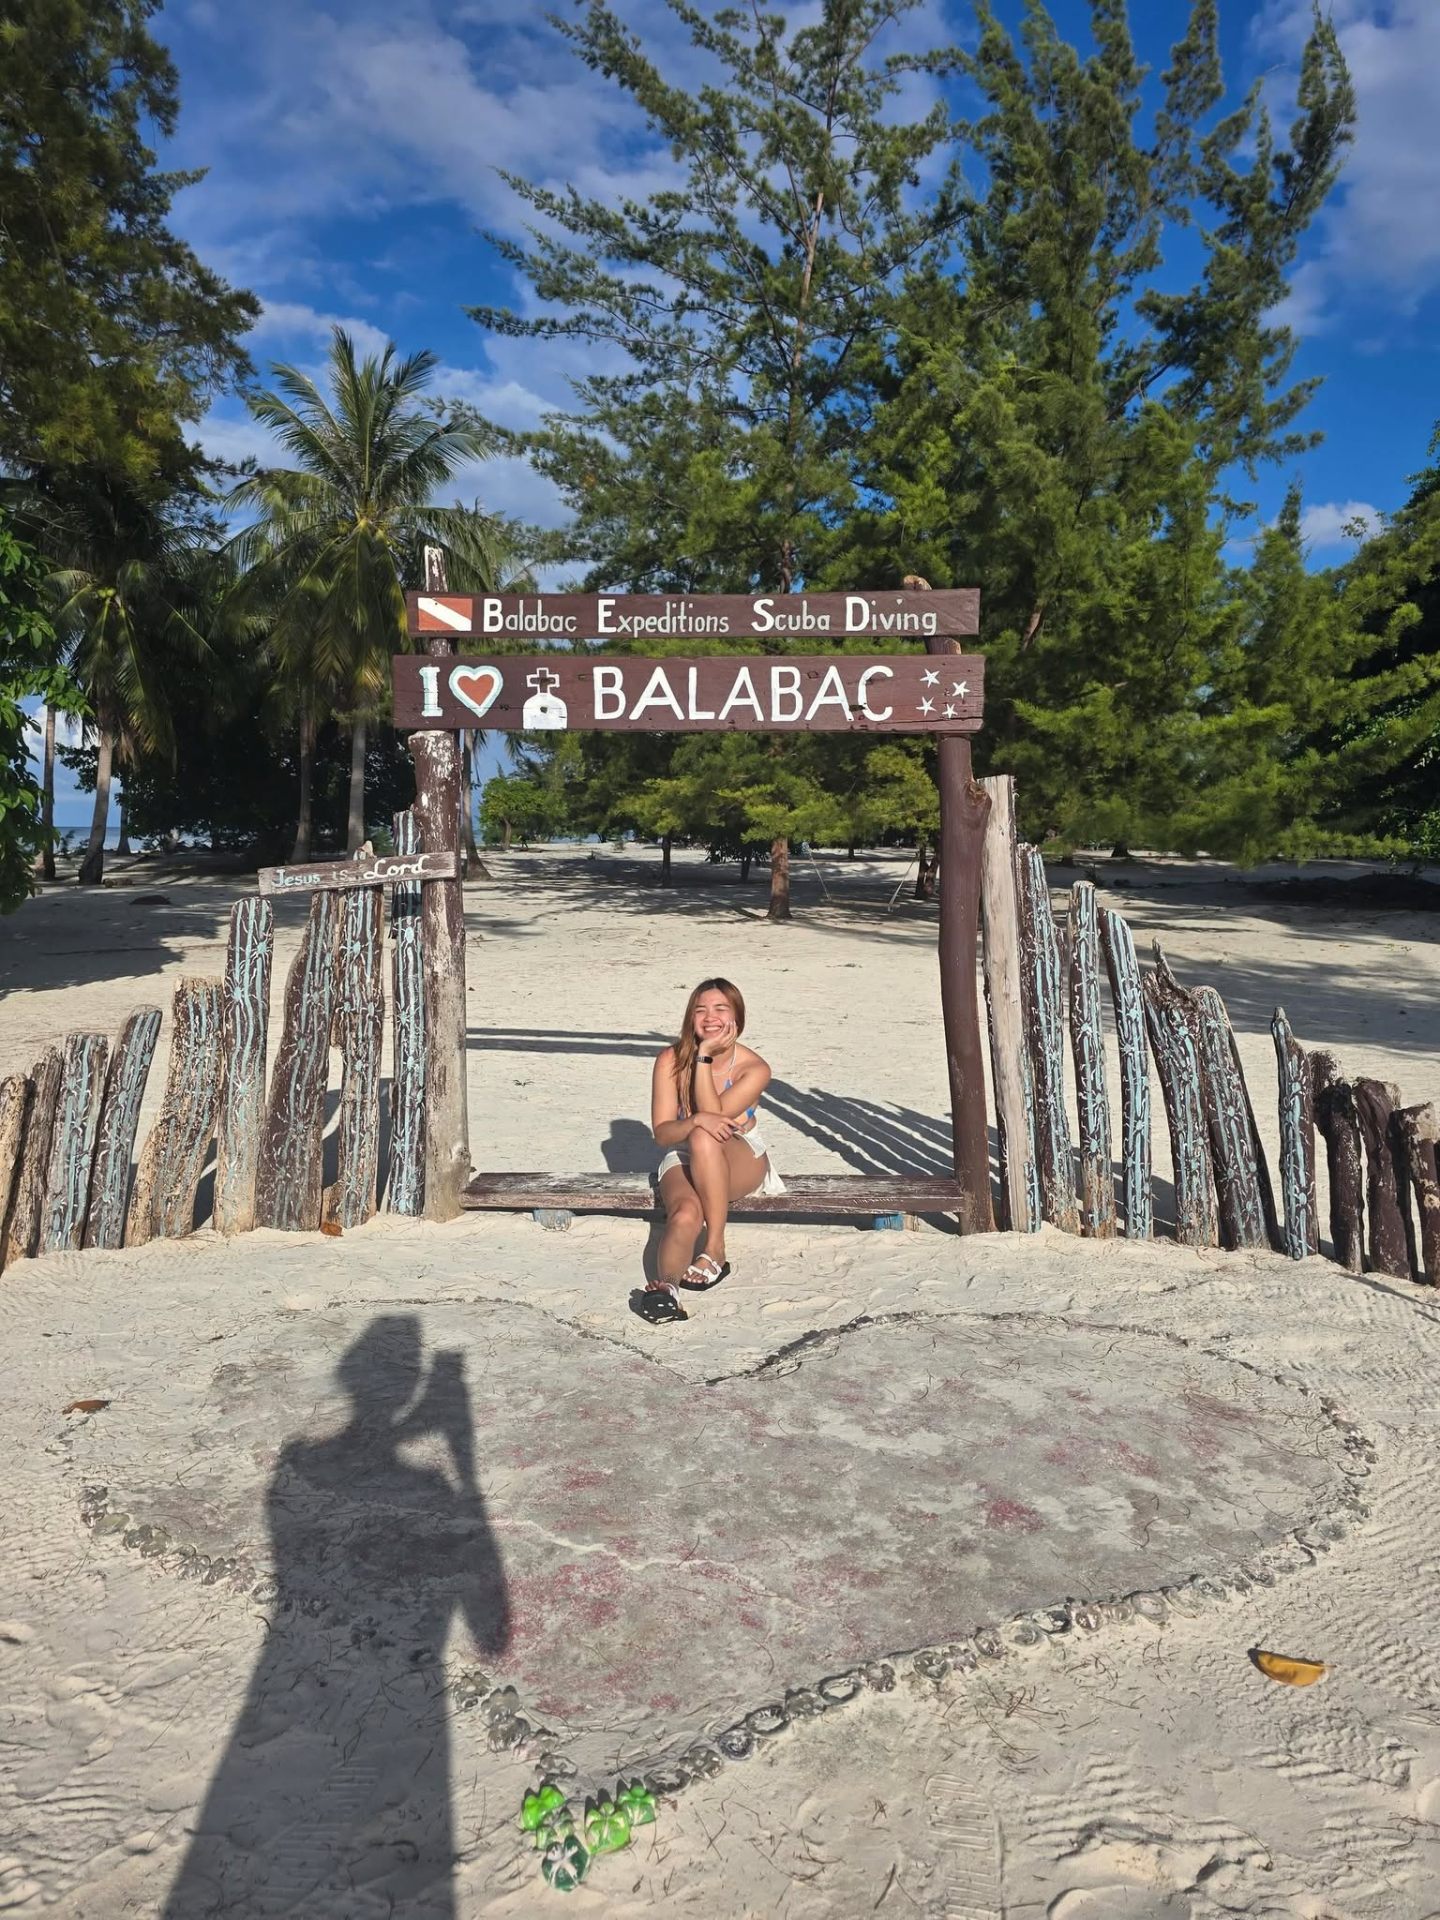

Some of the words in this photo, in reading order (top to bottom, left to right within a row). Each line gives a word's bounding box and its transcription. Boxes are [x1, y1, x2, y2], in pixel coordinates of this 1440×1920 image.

[483, 599, 577, 633] Balabac
[598, 599, 729, 636] Expeditions
[751, 599, 831, 632] Scuba
[845, 597, 937, 635] Diving
[419, 667, 443, 717] I
[594, 666, 893, 721] BALABAC
[272, 869, 321, 888] Jesus
[363, 855, 431, 880] Lord
